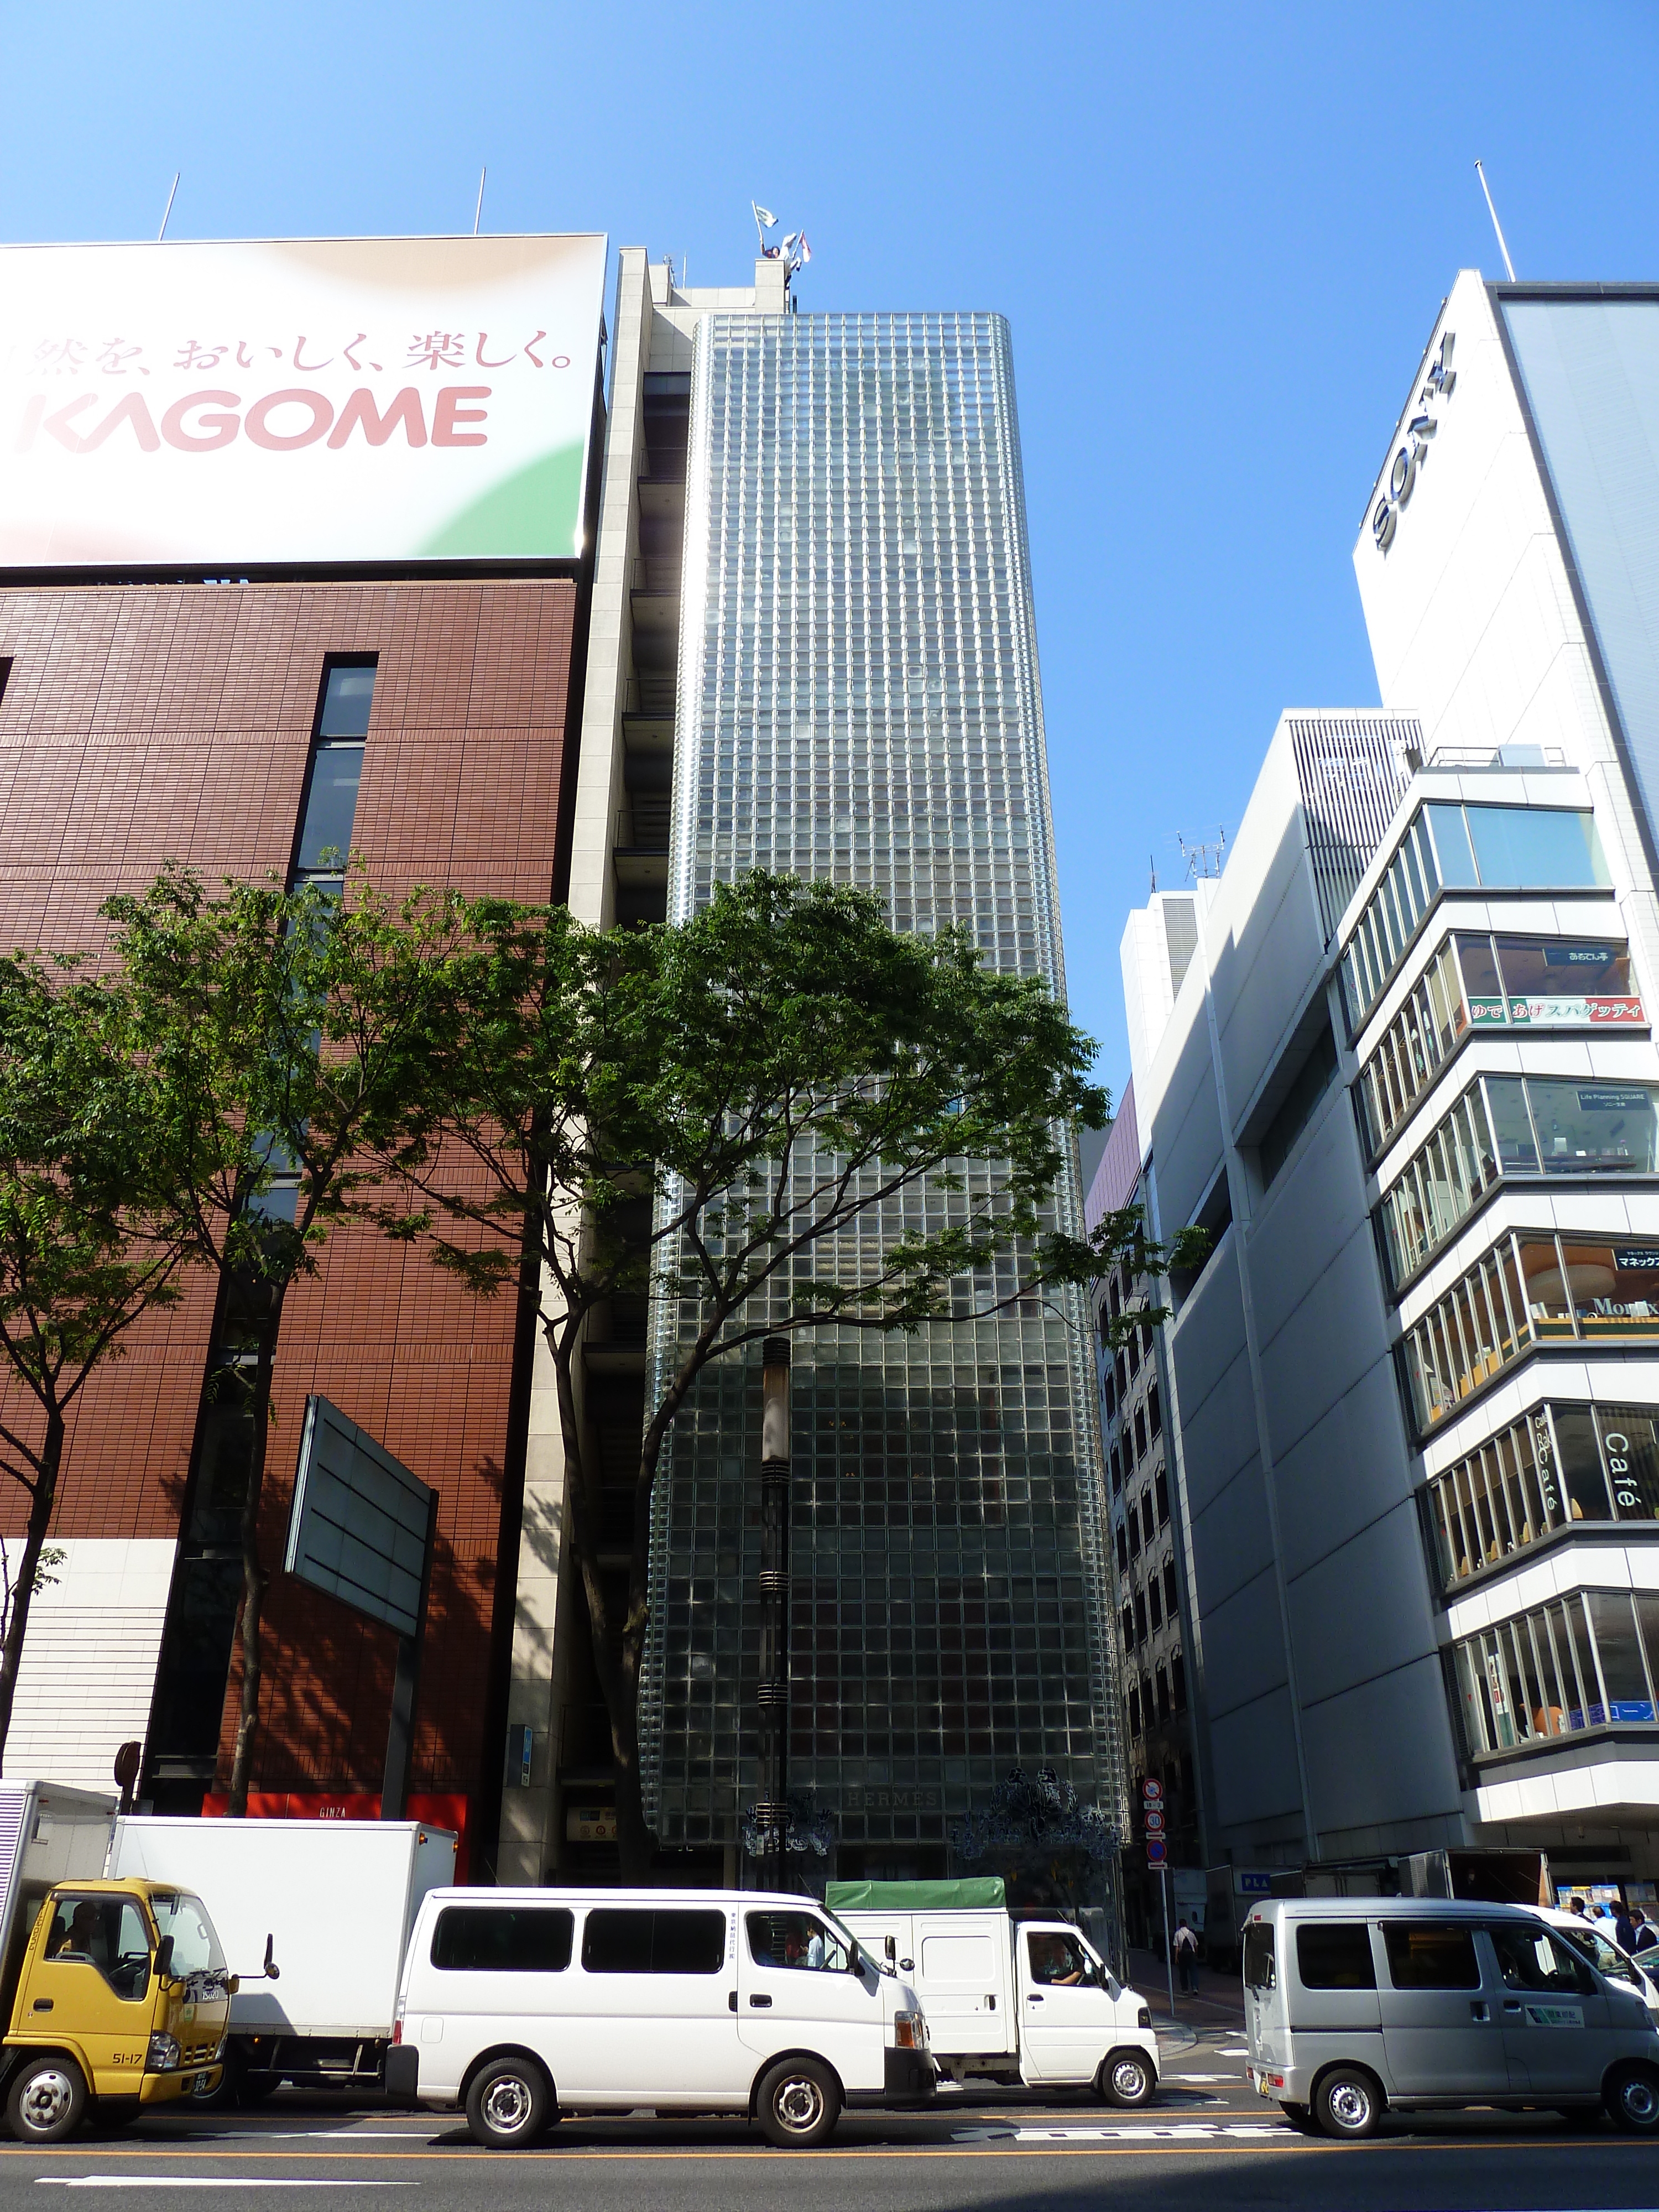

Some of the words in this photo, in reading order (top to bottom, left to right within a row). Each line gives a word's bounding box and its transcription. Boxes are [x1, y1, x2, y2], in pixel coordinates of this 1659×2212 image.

[4, 330, 572, 376] 然を、おいしく、楽しく。
[14, 386, 493, 453] KAGOME
[1592, 1298, 1659, 1315] Mox
[1605, 1433, 1642, 1507] Café
[320, 1807, 346, 1818] GINZA
[1149, 1816, 1160, 1826] 30
[112, 2053, 143, 2064] 51-17
